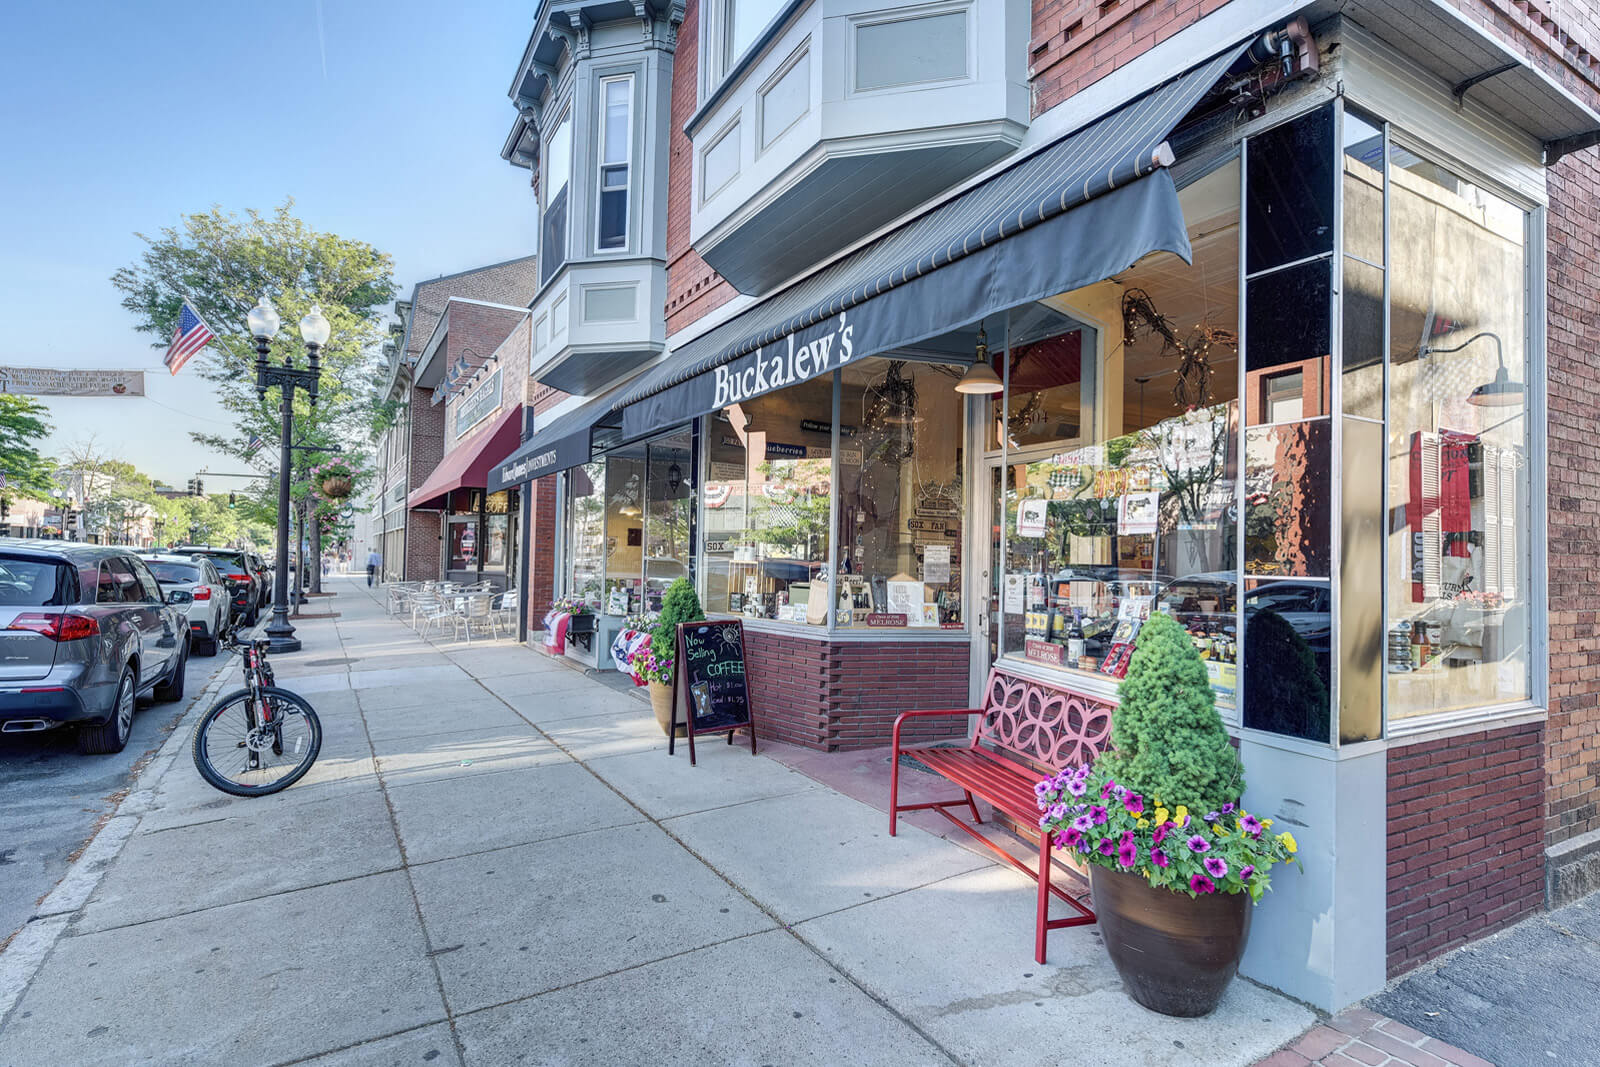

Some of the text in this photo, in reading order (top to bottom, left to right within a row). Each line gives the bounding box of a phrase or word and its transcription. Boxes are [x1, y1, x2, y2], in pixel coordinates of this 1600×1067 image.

[711, 311, 854, 409] Buckalew's
[707, 542, 725, 551] SOX
[685, 632, 705, 649] Now
[687, 649, 717, 662] Selling
[707, 661, 745, 676] COFFEE
